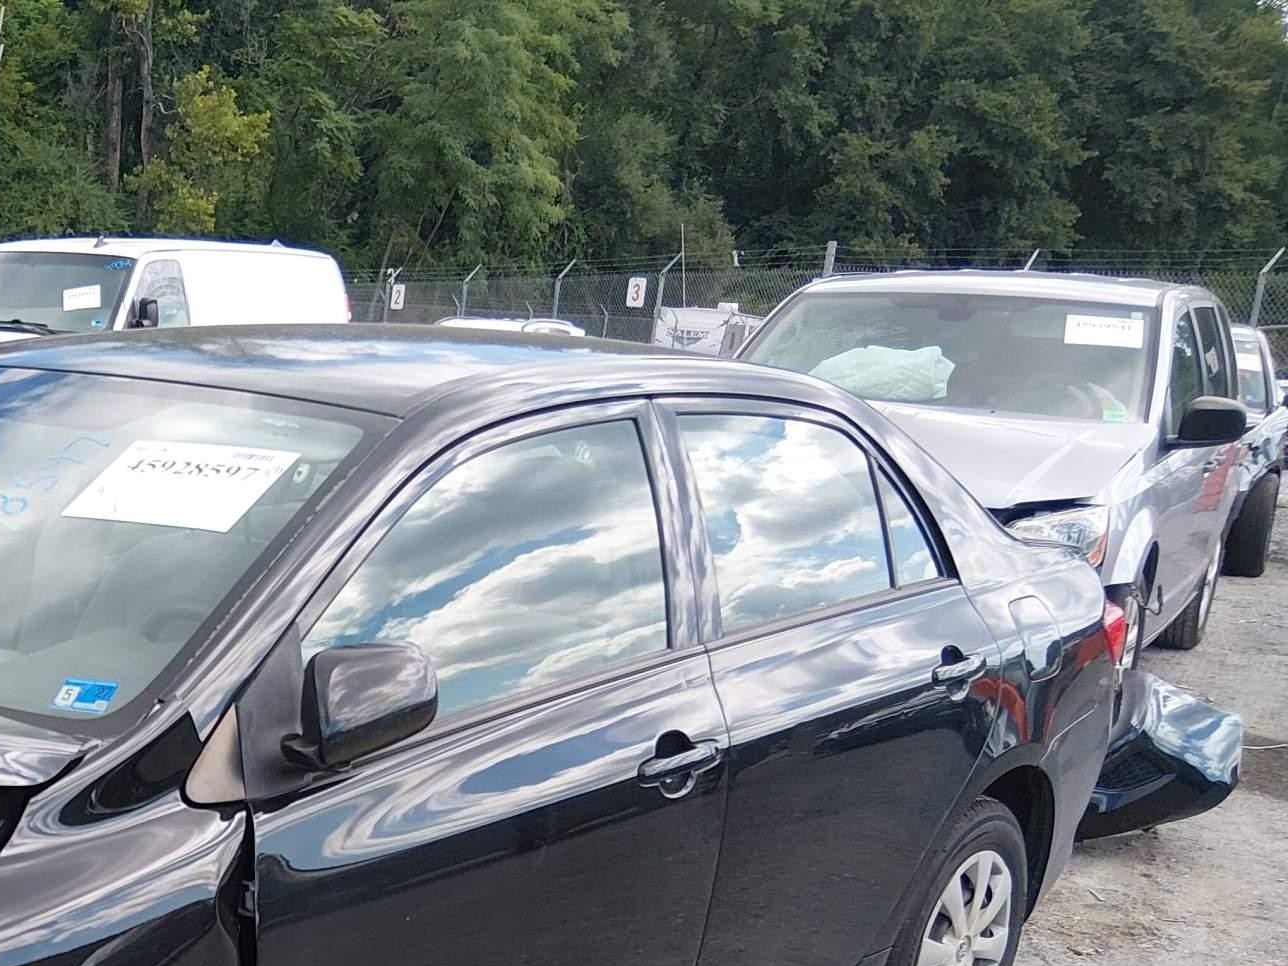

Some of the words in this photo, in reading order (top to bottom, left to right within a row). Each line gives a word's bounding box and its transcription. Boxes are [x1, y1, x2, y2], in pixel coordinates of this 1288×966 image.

[393, 289, 401, 305] 2
[632, 283, 640, 302] 3
[127, 457, 260, 481] 45928597
[61, 688, 74, 702] 5
[95, 687, 112, 699] 27
